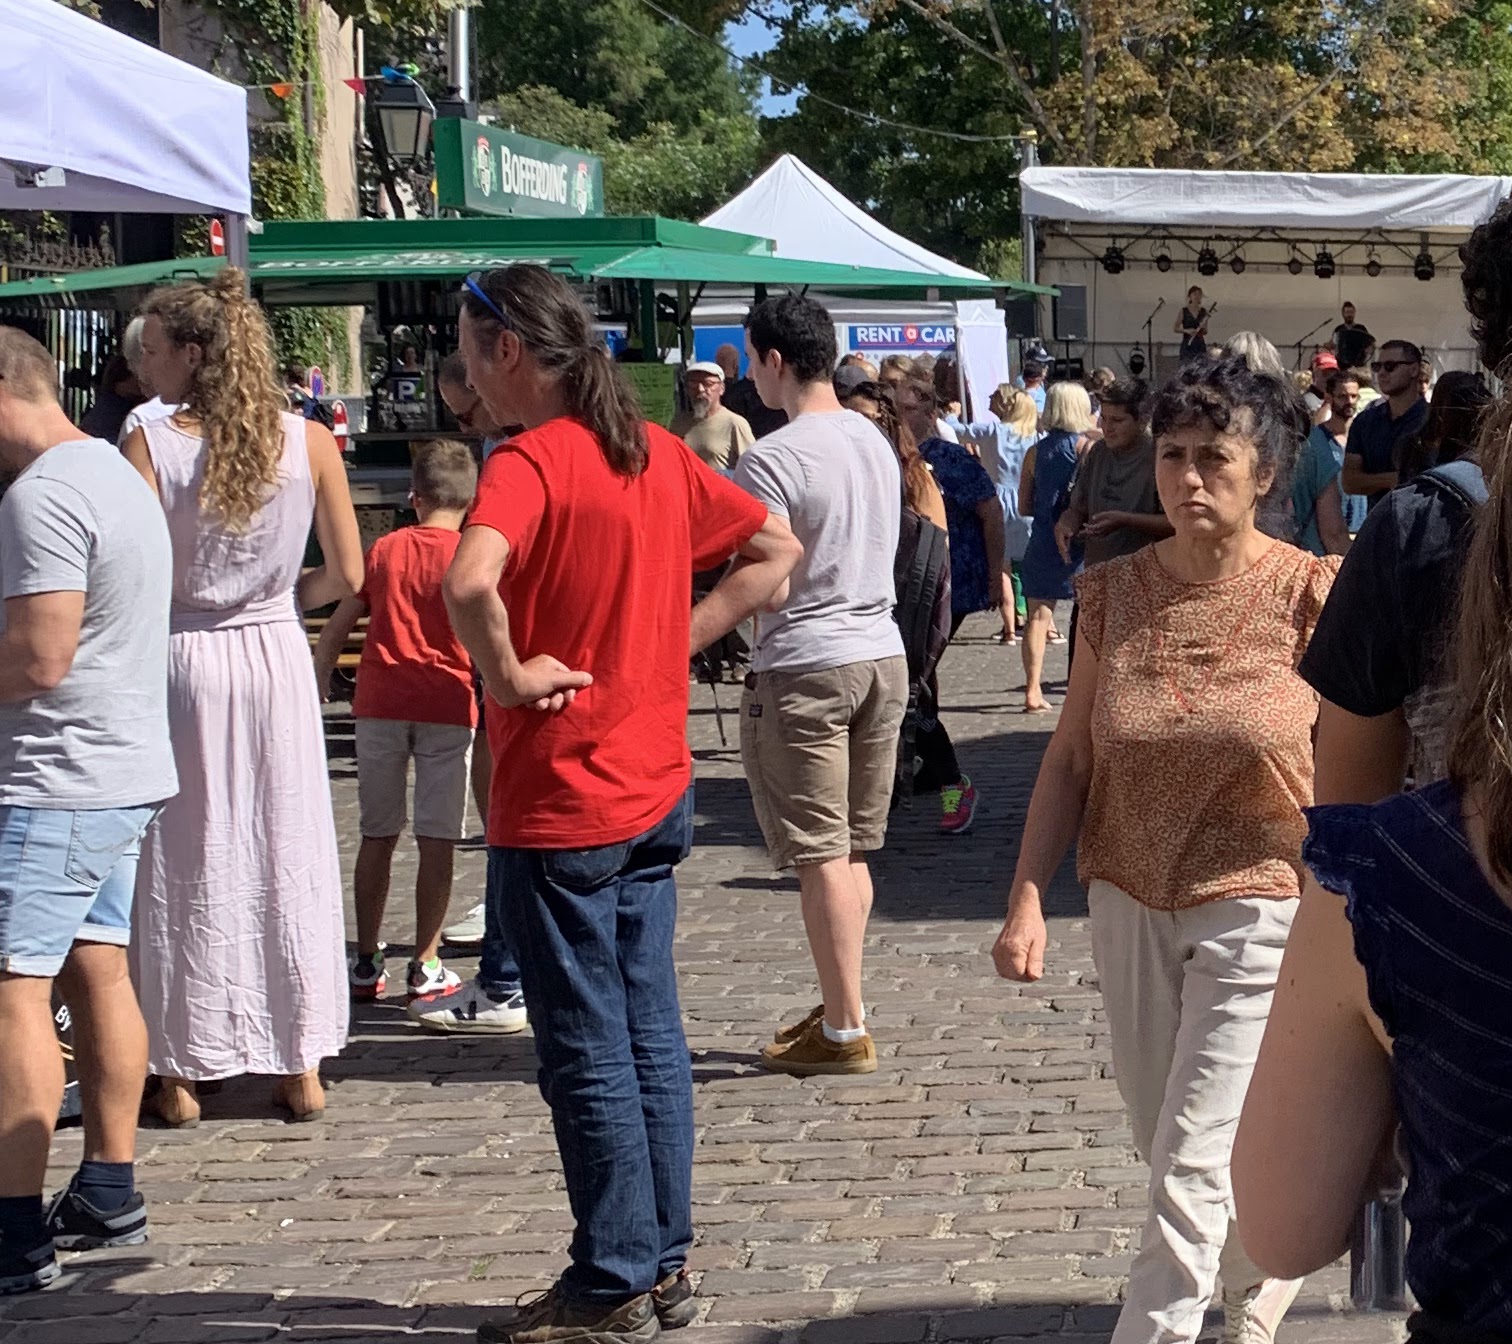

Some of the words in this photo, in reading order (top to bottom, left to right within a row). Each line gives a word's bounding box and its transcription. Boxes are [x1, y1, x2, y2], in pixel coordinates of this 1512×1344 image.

[501, 145, 568, 205] BOFFERDING
[856, 327, 902, 343] RENT
[906, 328, 917, 340] a
[921, 327, 956, 343] CAR
